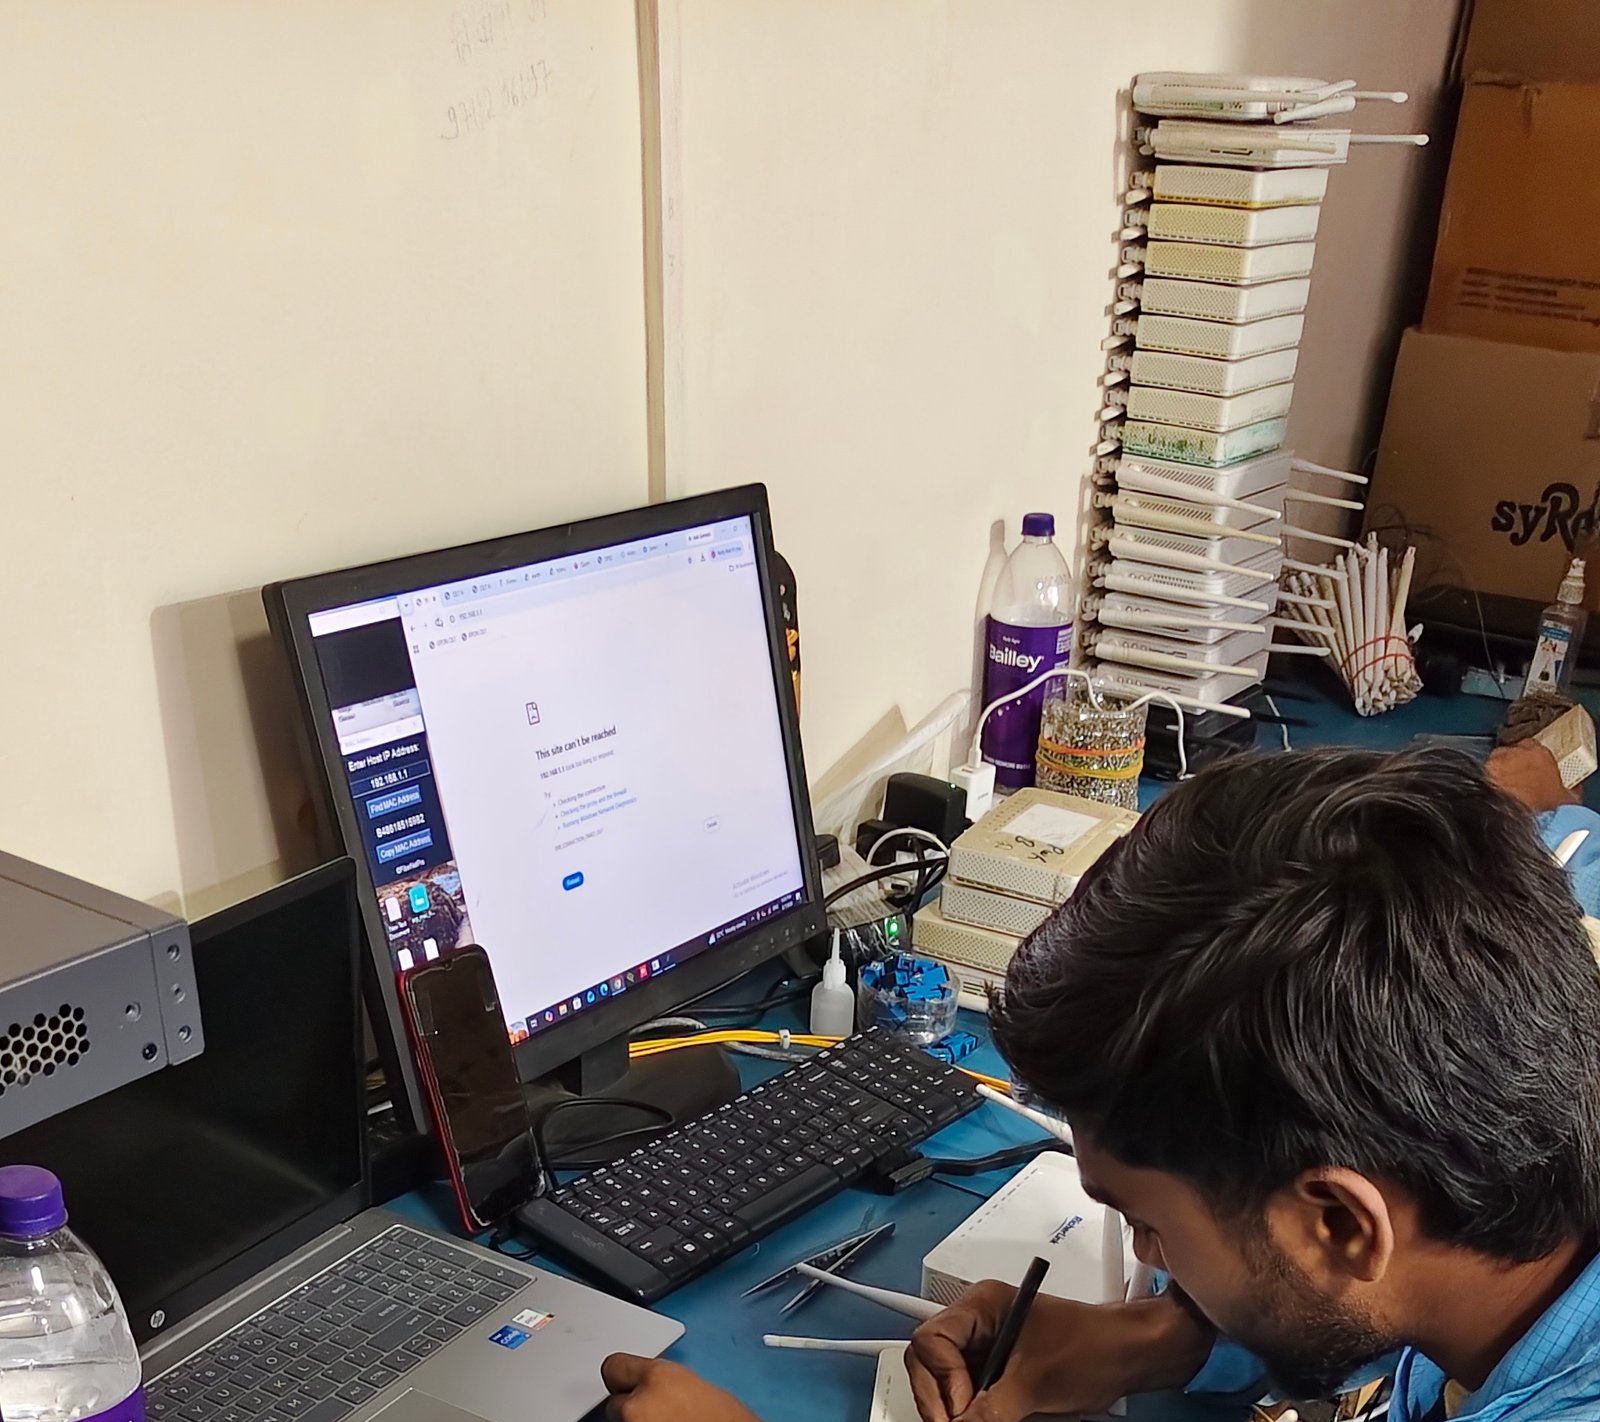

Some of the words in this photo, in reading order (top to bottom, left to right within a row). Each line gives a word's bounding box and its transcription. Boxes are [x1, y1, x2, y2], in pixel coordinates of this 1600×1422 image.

[989, 644, 1044, 673] Bailley
[536, 748, 550, 761] This
[551, 744, 563, 756] site
[564, 737, 581, 752] can't
[581, 735, 590, 746] be
[591, 725, 617, 742] reached
[348, 758, 367, 772] Enter
[367, 753, 383, 766] Host
[383, 750, 391, 761] IP
[370, 769, 409, 789] 192.168.1.1
[384, 796, 398, 810] MAC
[395, 840, 410, 854] MAC
